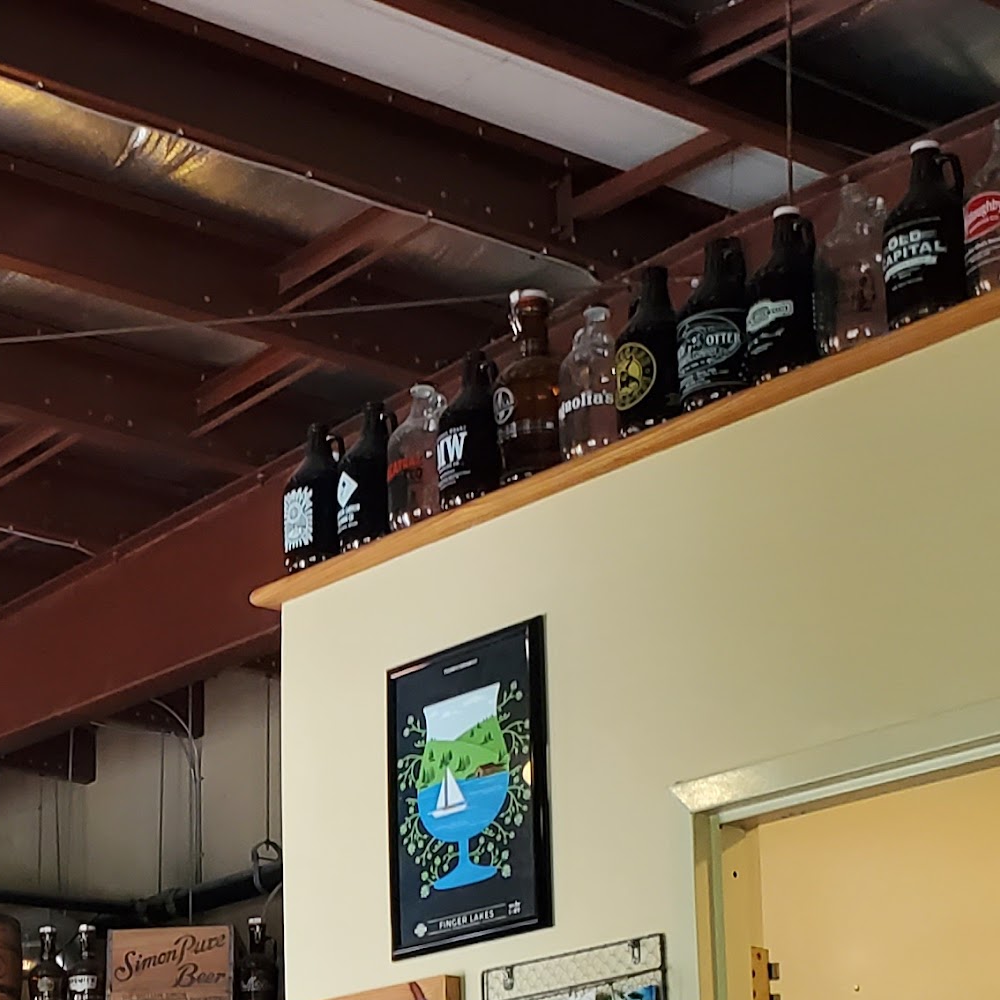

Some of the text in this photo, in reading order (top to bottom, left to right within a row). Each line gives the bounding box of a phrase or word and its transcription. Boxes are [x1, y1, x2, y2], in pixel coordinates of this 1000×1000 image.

[888, 229, 921, 251] OLD
[439, 909, 495, 930] FINGER LAKES
[114, 934, 226, 983] Simon Pure
[172, 962, 226, 988] Beer
